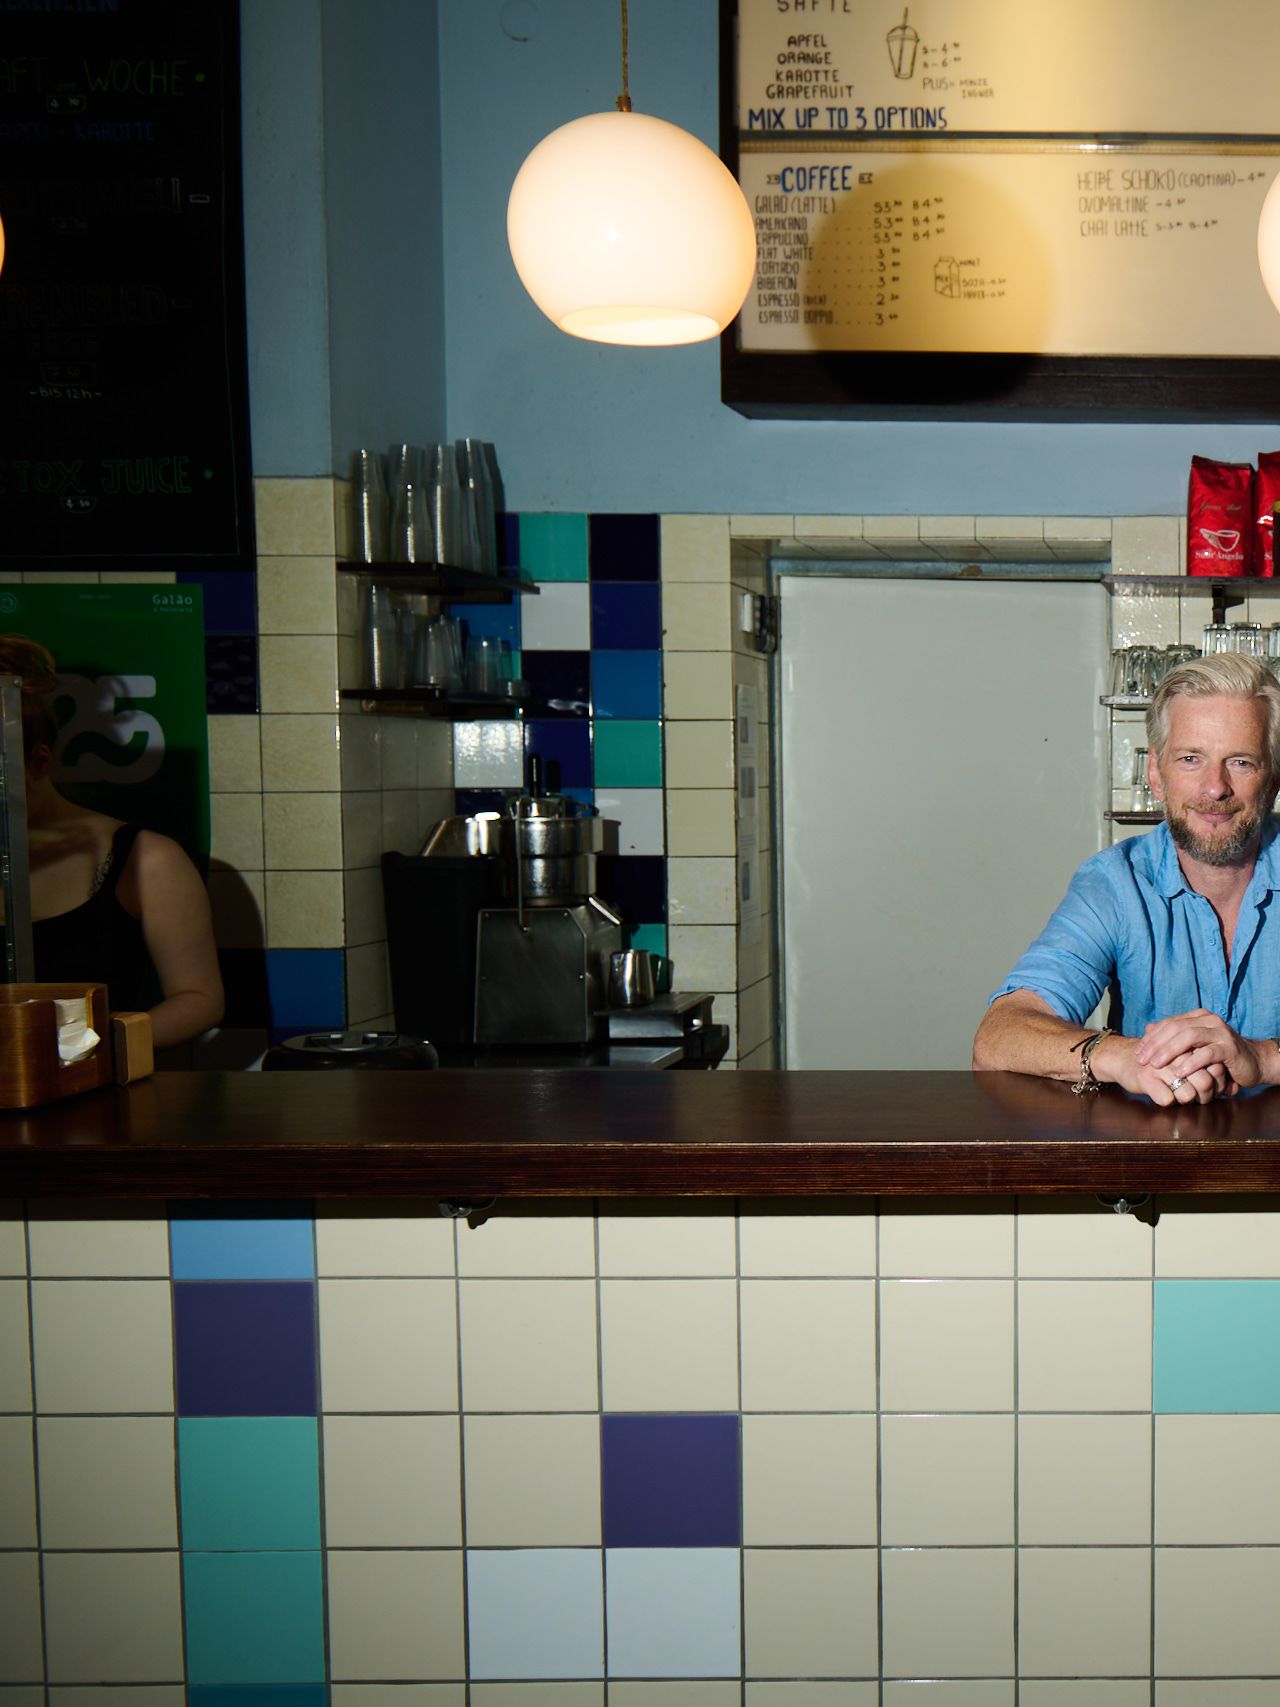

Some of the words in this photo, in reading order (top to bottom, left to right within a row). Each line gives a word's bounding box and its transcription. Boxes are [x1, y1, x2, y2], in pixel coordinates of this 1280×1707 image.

[787, 34, 828, 48] APFEL
[777, 51, 832, 65] ORANGE
[82, 56, 190, 96] WOCHE
[775, 69, 840, 83] KAROTTE
[766, 84, 855, 99] GRAPEFRUIT
[749, 108, 785, 130] MIX
[796, 107, 819, 129] UP
[826, 107, 848, 129] TO
[856, 107, 867, 129] 3
[875, 107, 948, 129] OPTIONS
[781, 165, 853, 192] COFFEE
[102, 455, 193, 495] JUICE
